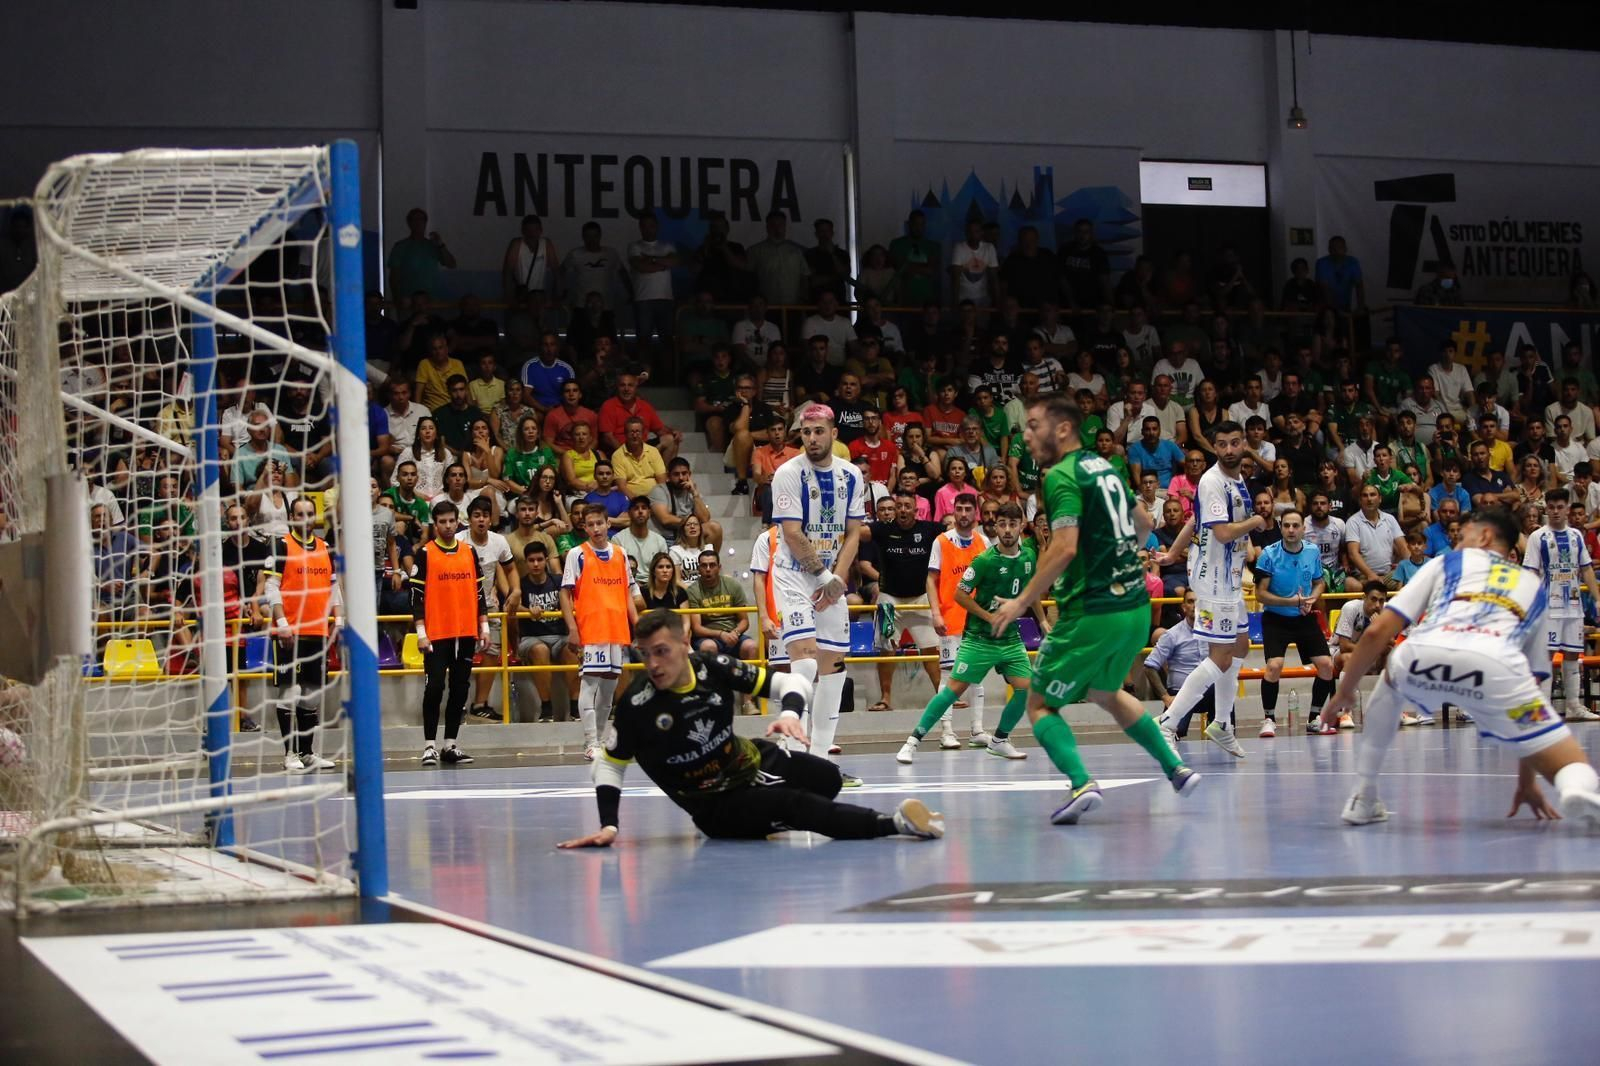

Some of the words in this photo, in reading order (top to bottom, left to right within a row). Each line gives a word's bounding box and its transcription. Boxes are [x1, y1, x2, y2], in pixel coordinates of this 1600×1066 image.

[473, 151, 801, 223] ANTEQUERA
[1449, 224, 1486, 241] SITIO
[1488, 215, 1583, 244] DÓLMENES
[1462, 245, 1585, 278] ANTEQUERA
[1450, 319, 1600, 372] #AN
[1096, 473, 1137, 540] 12
[886, 547, 927, 555] ANTEUERA
[297, 566, 328, 575] uhlsport
[438, 572, 471, 582] uhlsport
[1488, 564, 1521, 591] 8
[593, 576, 622, 587] uhlsport
[1011, 577, 1020, 595] 8
[1548, 631, 1556, 642] 12
[595, 651, 606, 663] 16
[1408, 659, 1484, 688] KIA
[666, 750, 700, 764] CAJA
